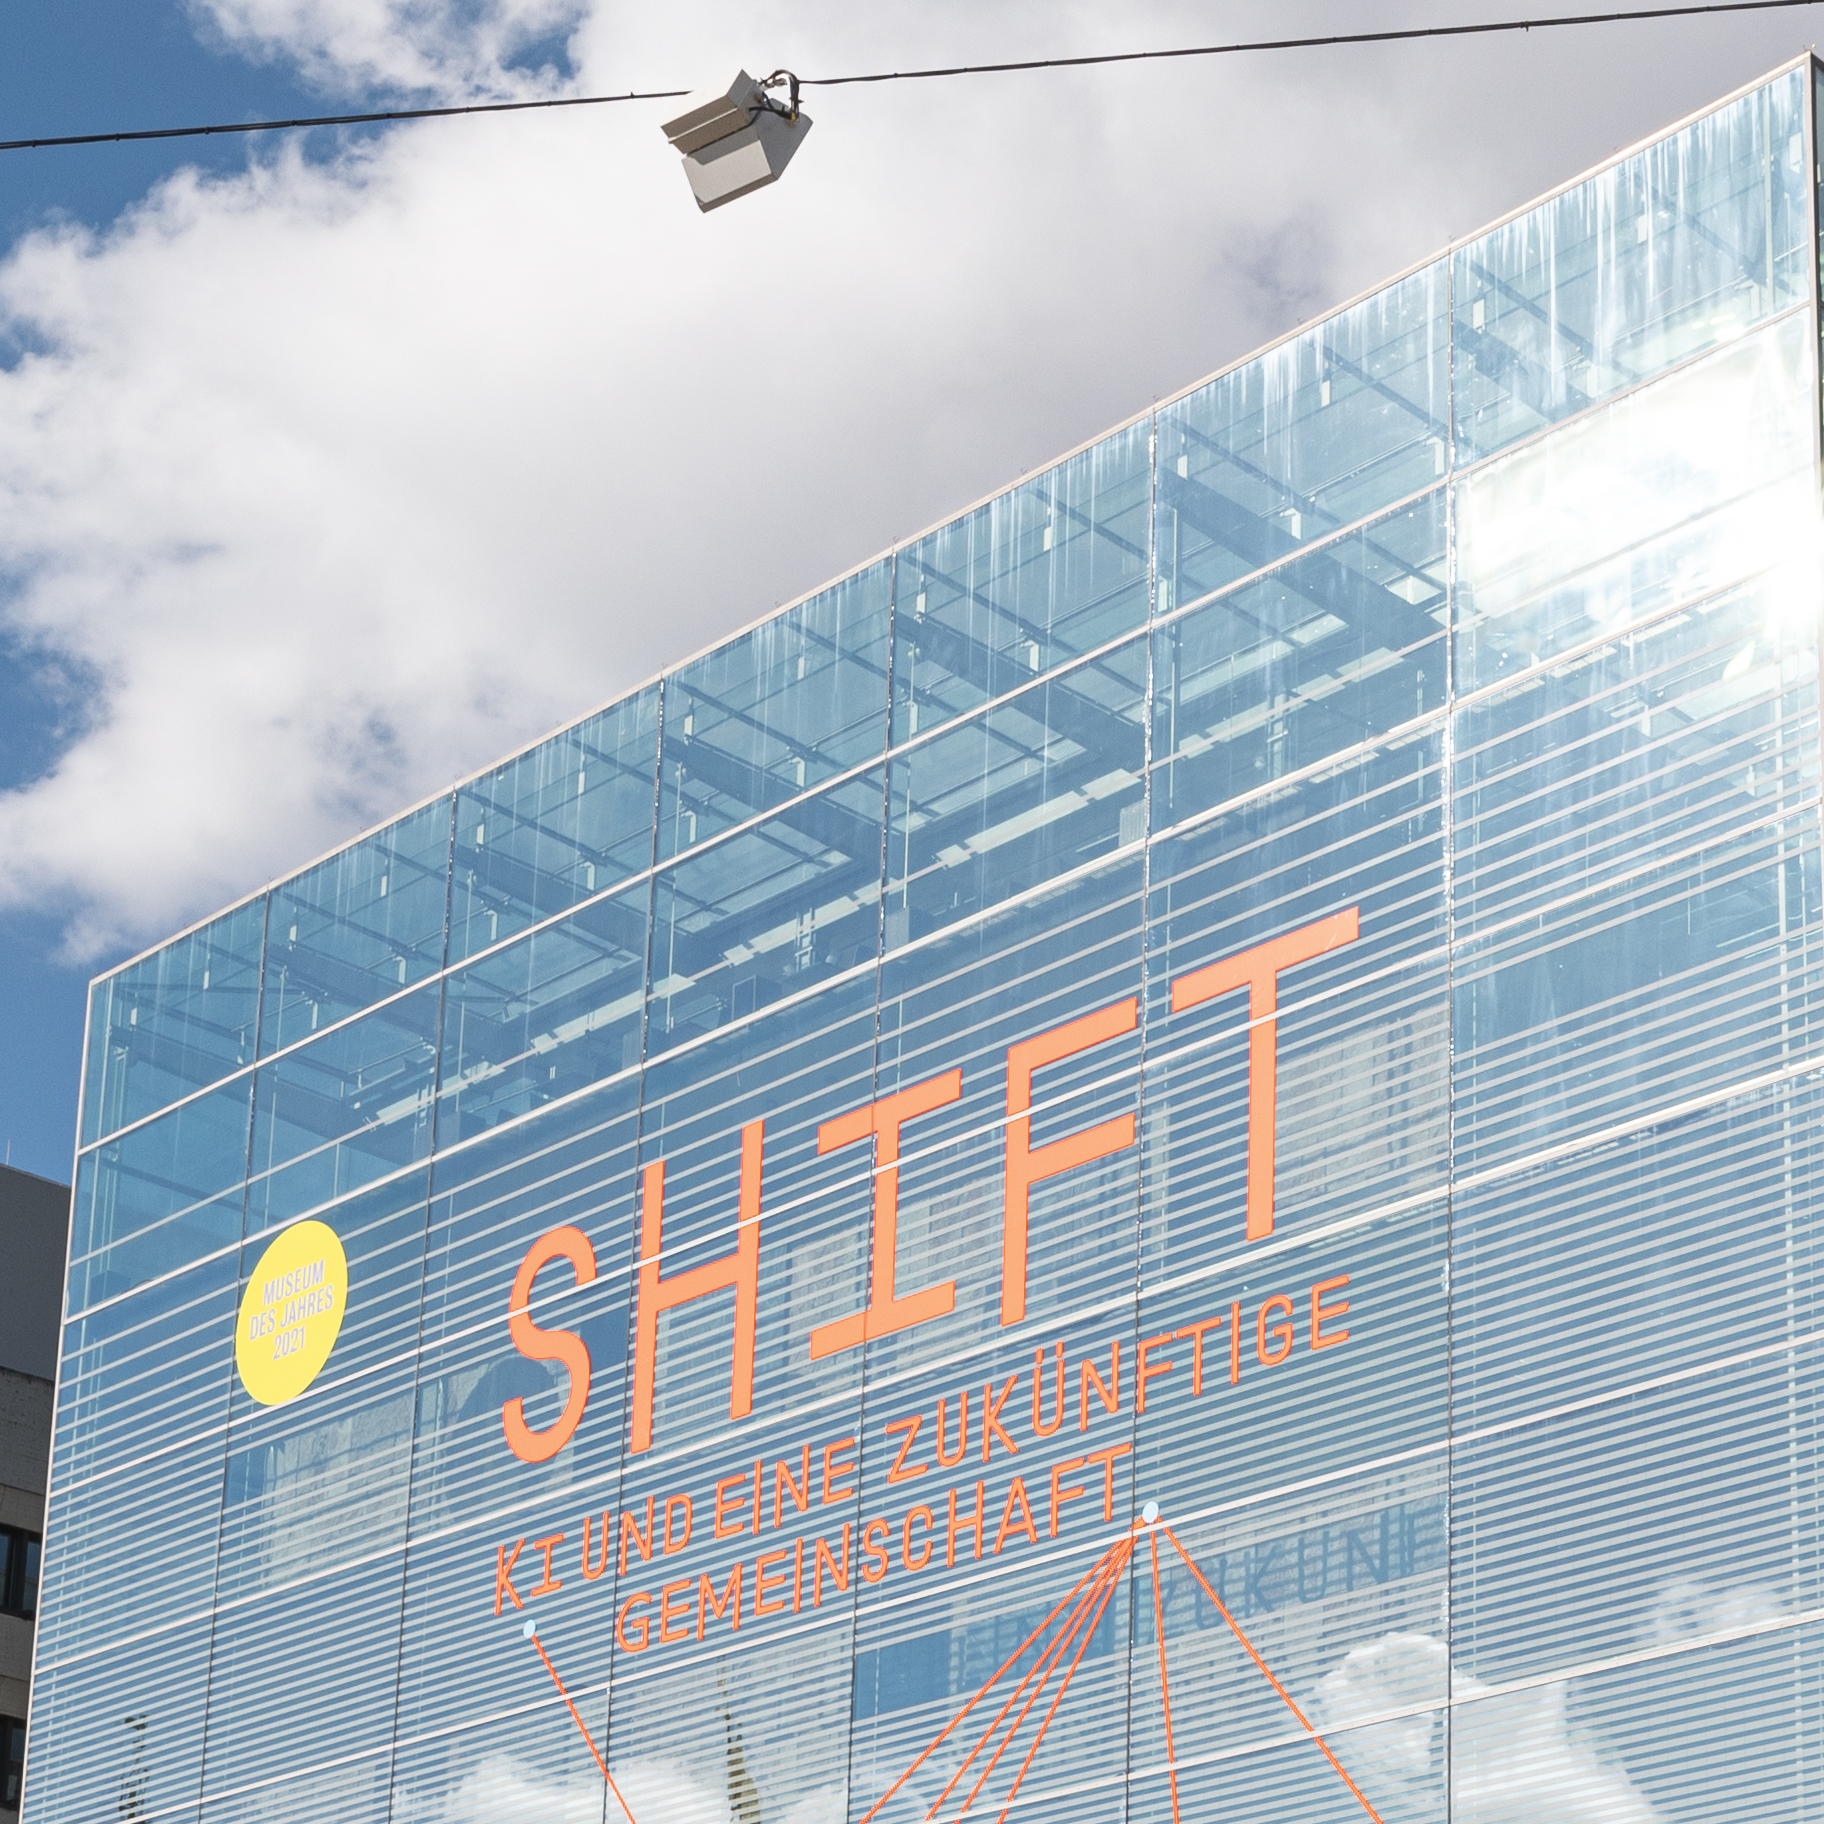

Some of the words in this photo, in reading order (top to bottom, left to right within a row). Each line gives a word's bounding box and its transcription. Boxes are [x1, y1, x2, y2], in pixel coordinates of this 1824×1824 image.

[503, 906, 1359, 1463] SHIFT
[249, 1308, 275, 1341] DES
[280, 1284, 334, 1328] JAHRES
[262, 1258, 325, 1306] MUSEUM
[273, 1325, 306, 1360] 2021
[494, 1533, 564, 1616] KI
[581, 1493, 693, 1577] UND
[714, 1437, 855, 1539] EINE
[885, 1274, 1350, 1485] ZUKÜNFTIGE
[616, 1442, 1132, 1653] GEMEINSCHAFT
